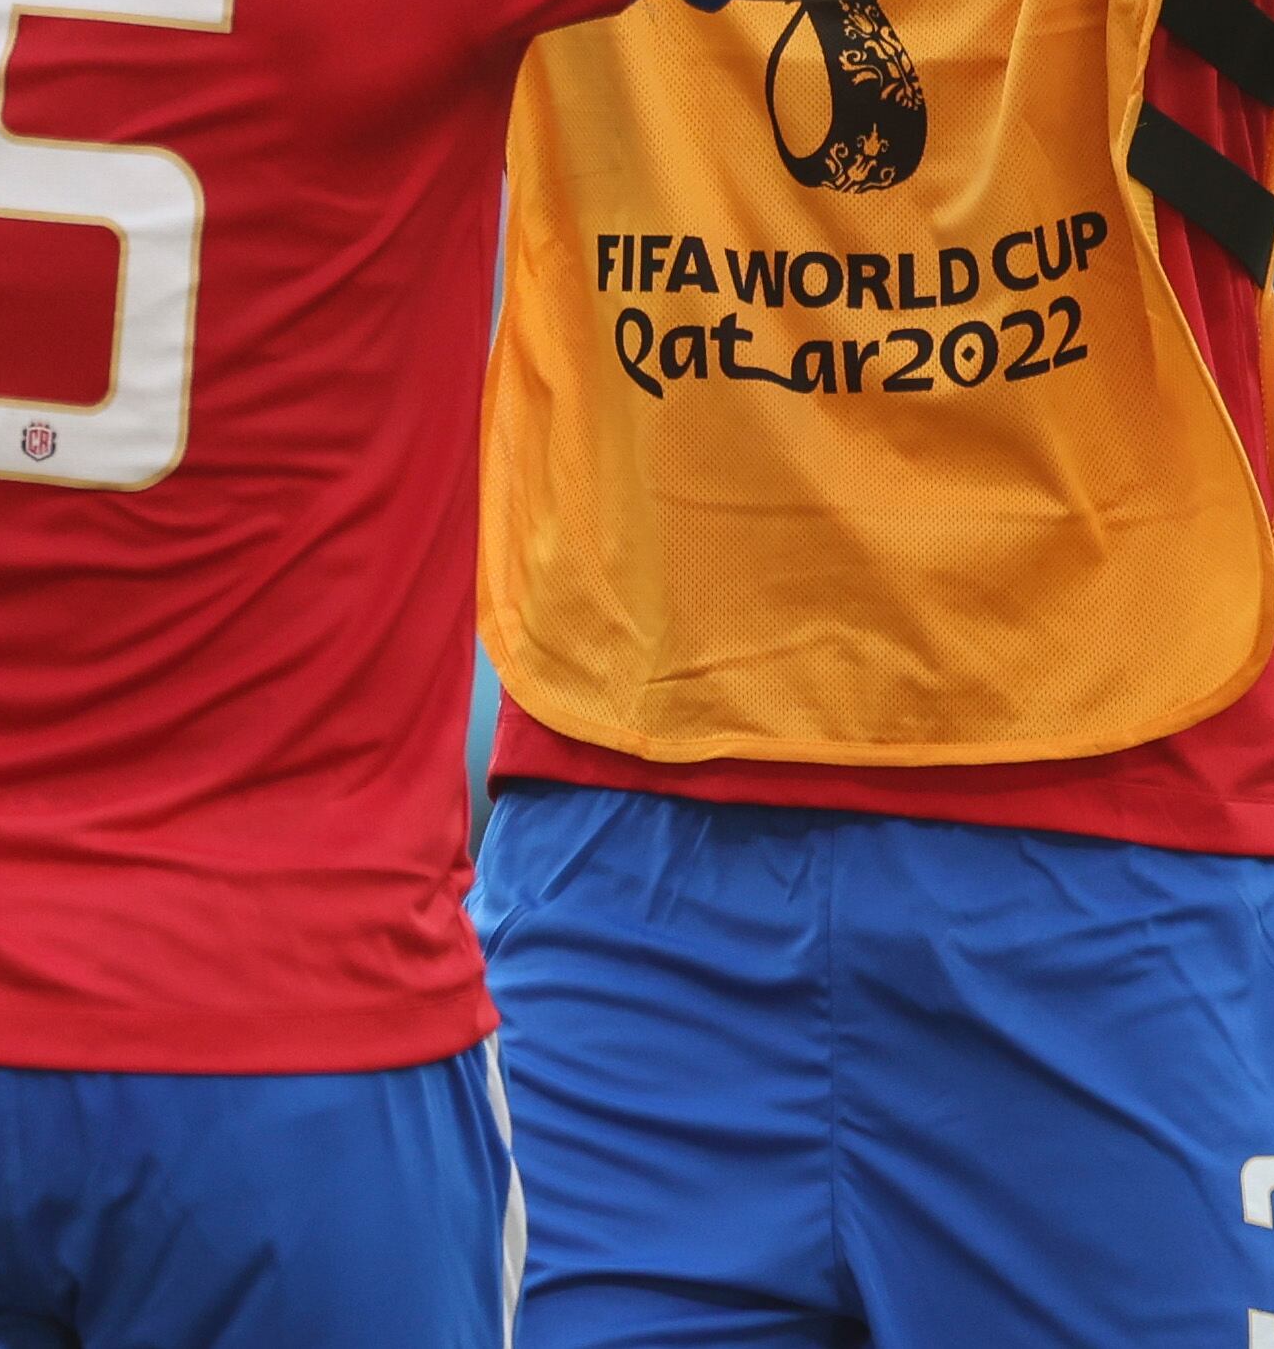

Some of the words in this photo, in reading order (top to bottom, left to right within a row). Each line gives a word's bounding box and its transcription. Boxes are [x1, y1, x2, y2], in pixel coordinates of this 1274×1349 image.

[597, 234, 719, 292] FIFA
[725, 246, 980, 311] WORLD
[992, 211, 1108, 291] CUP
